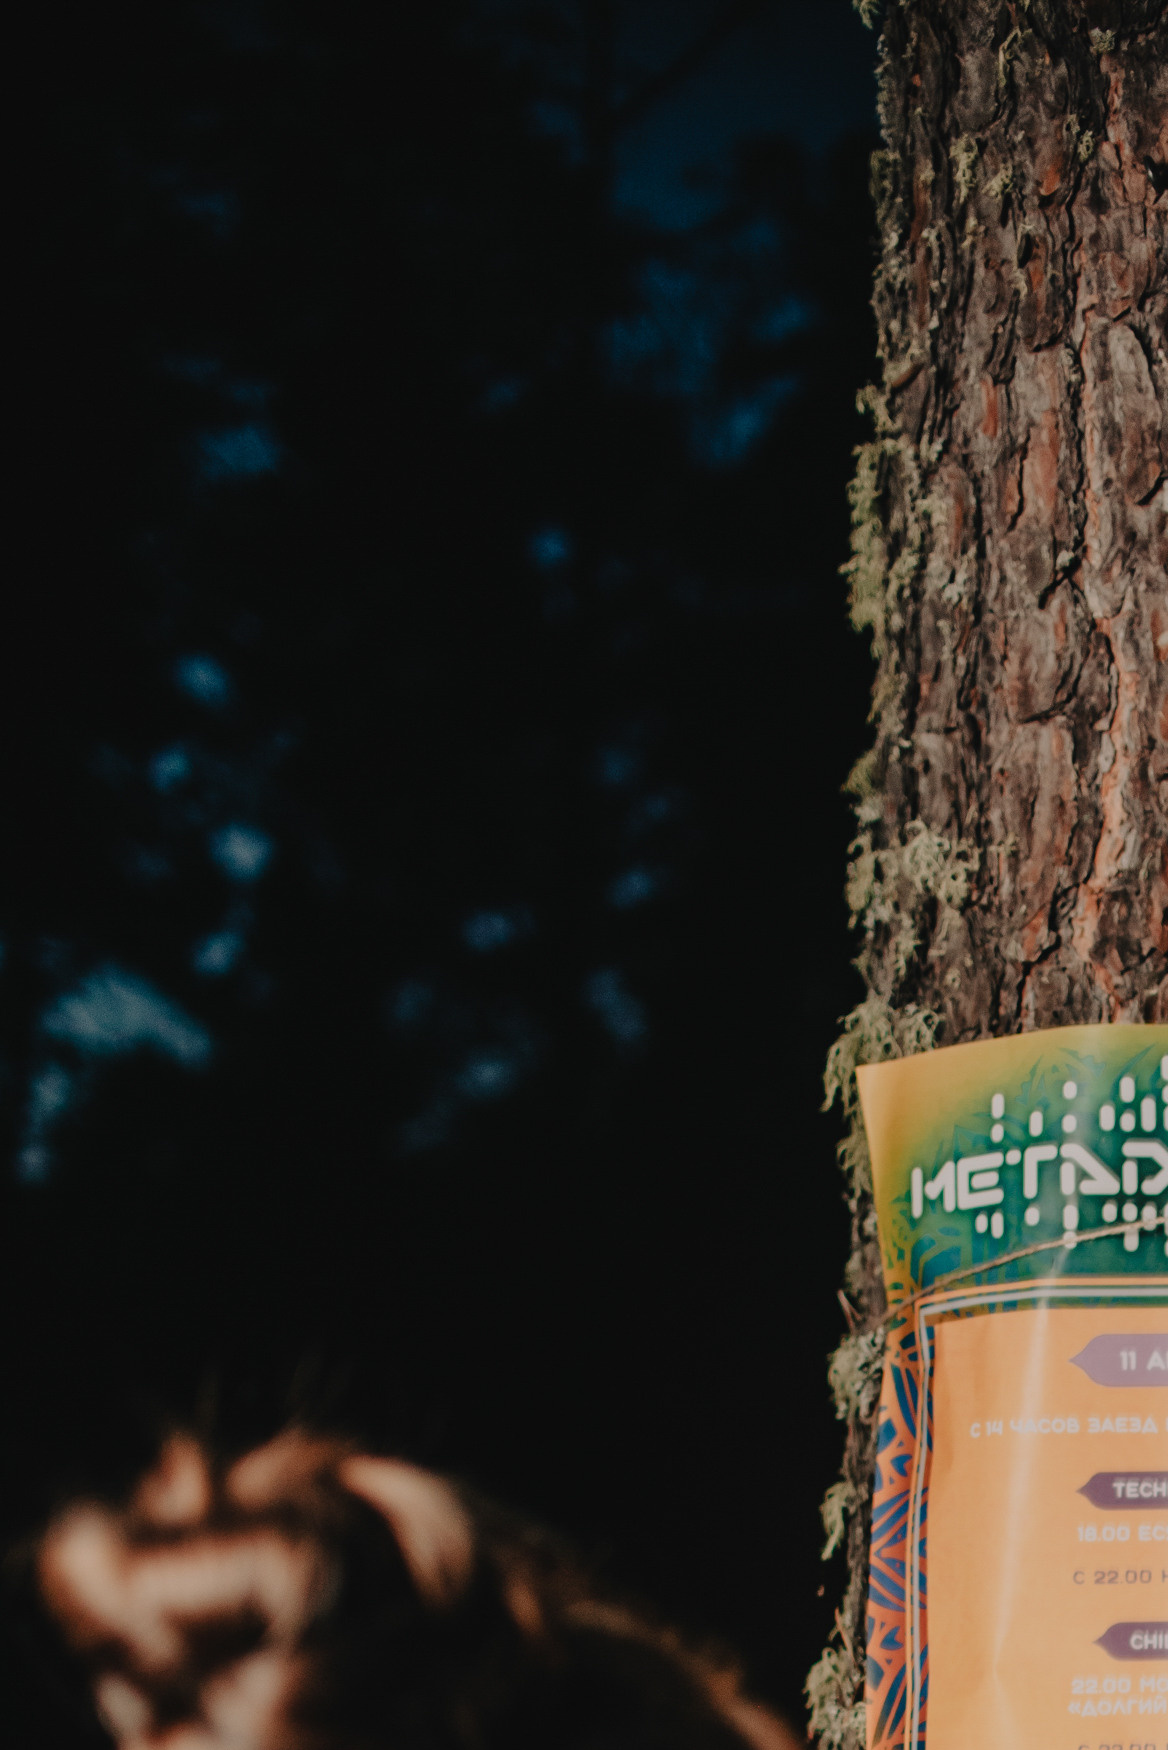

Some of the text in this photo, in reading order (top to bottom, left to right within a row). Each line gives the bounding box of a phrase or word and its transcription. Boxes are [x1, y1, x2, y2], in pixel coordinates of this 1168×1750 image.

[1119, 1350, 1137, 1371] 11
[986, 1420, 1003, 1436] 14
[1010, 1417, 1080, 1435] ЧАСОВ
[1088, 1416, 1158, 1434] ЗАЕЗД
[1077, 1524, 1130, 1543] 18.00
[1093, 1569, 1153, 1584] 22.00
[1071, 1677, 1131, 1695] 22.00
[1067, 1696, 1167, 1717] «ДОЛГИЙ
